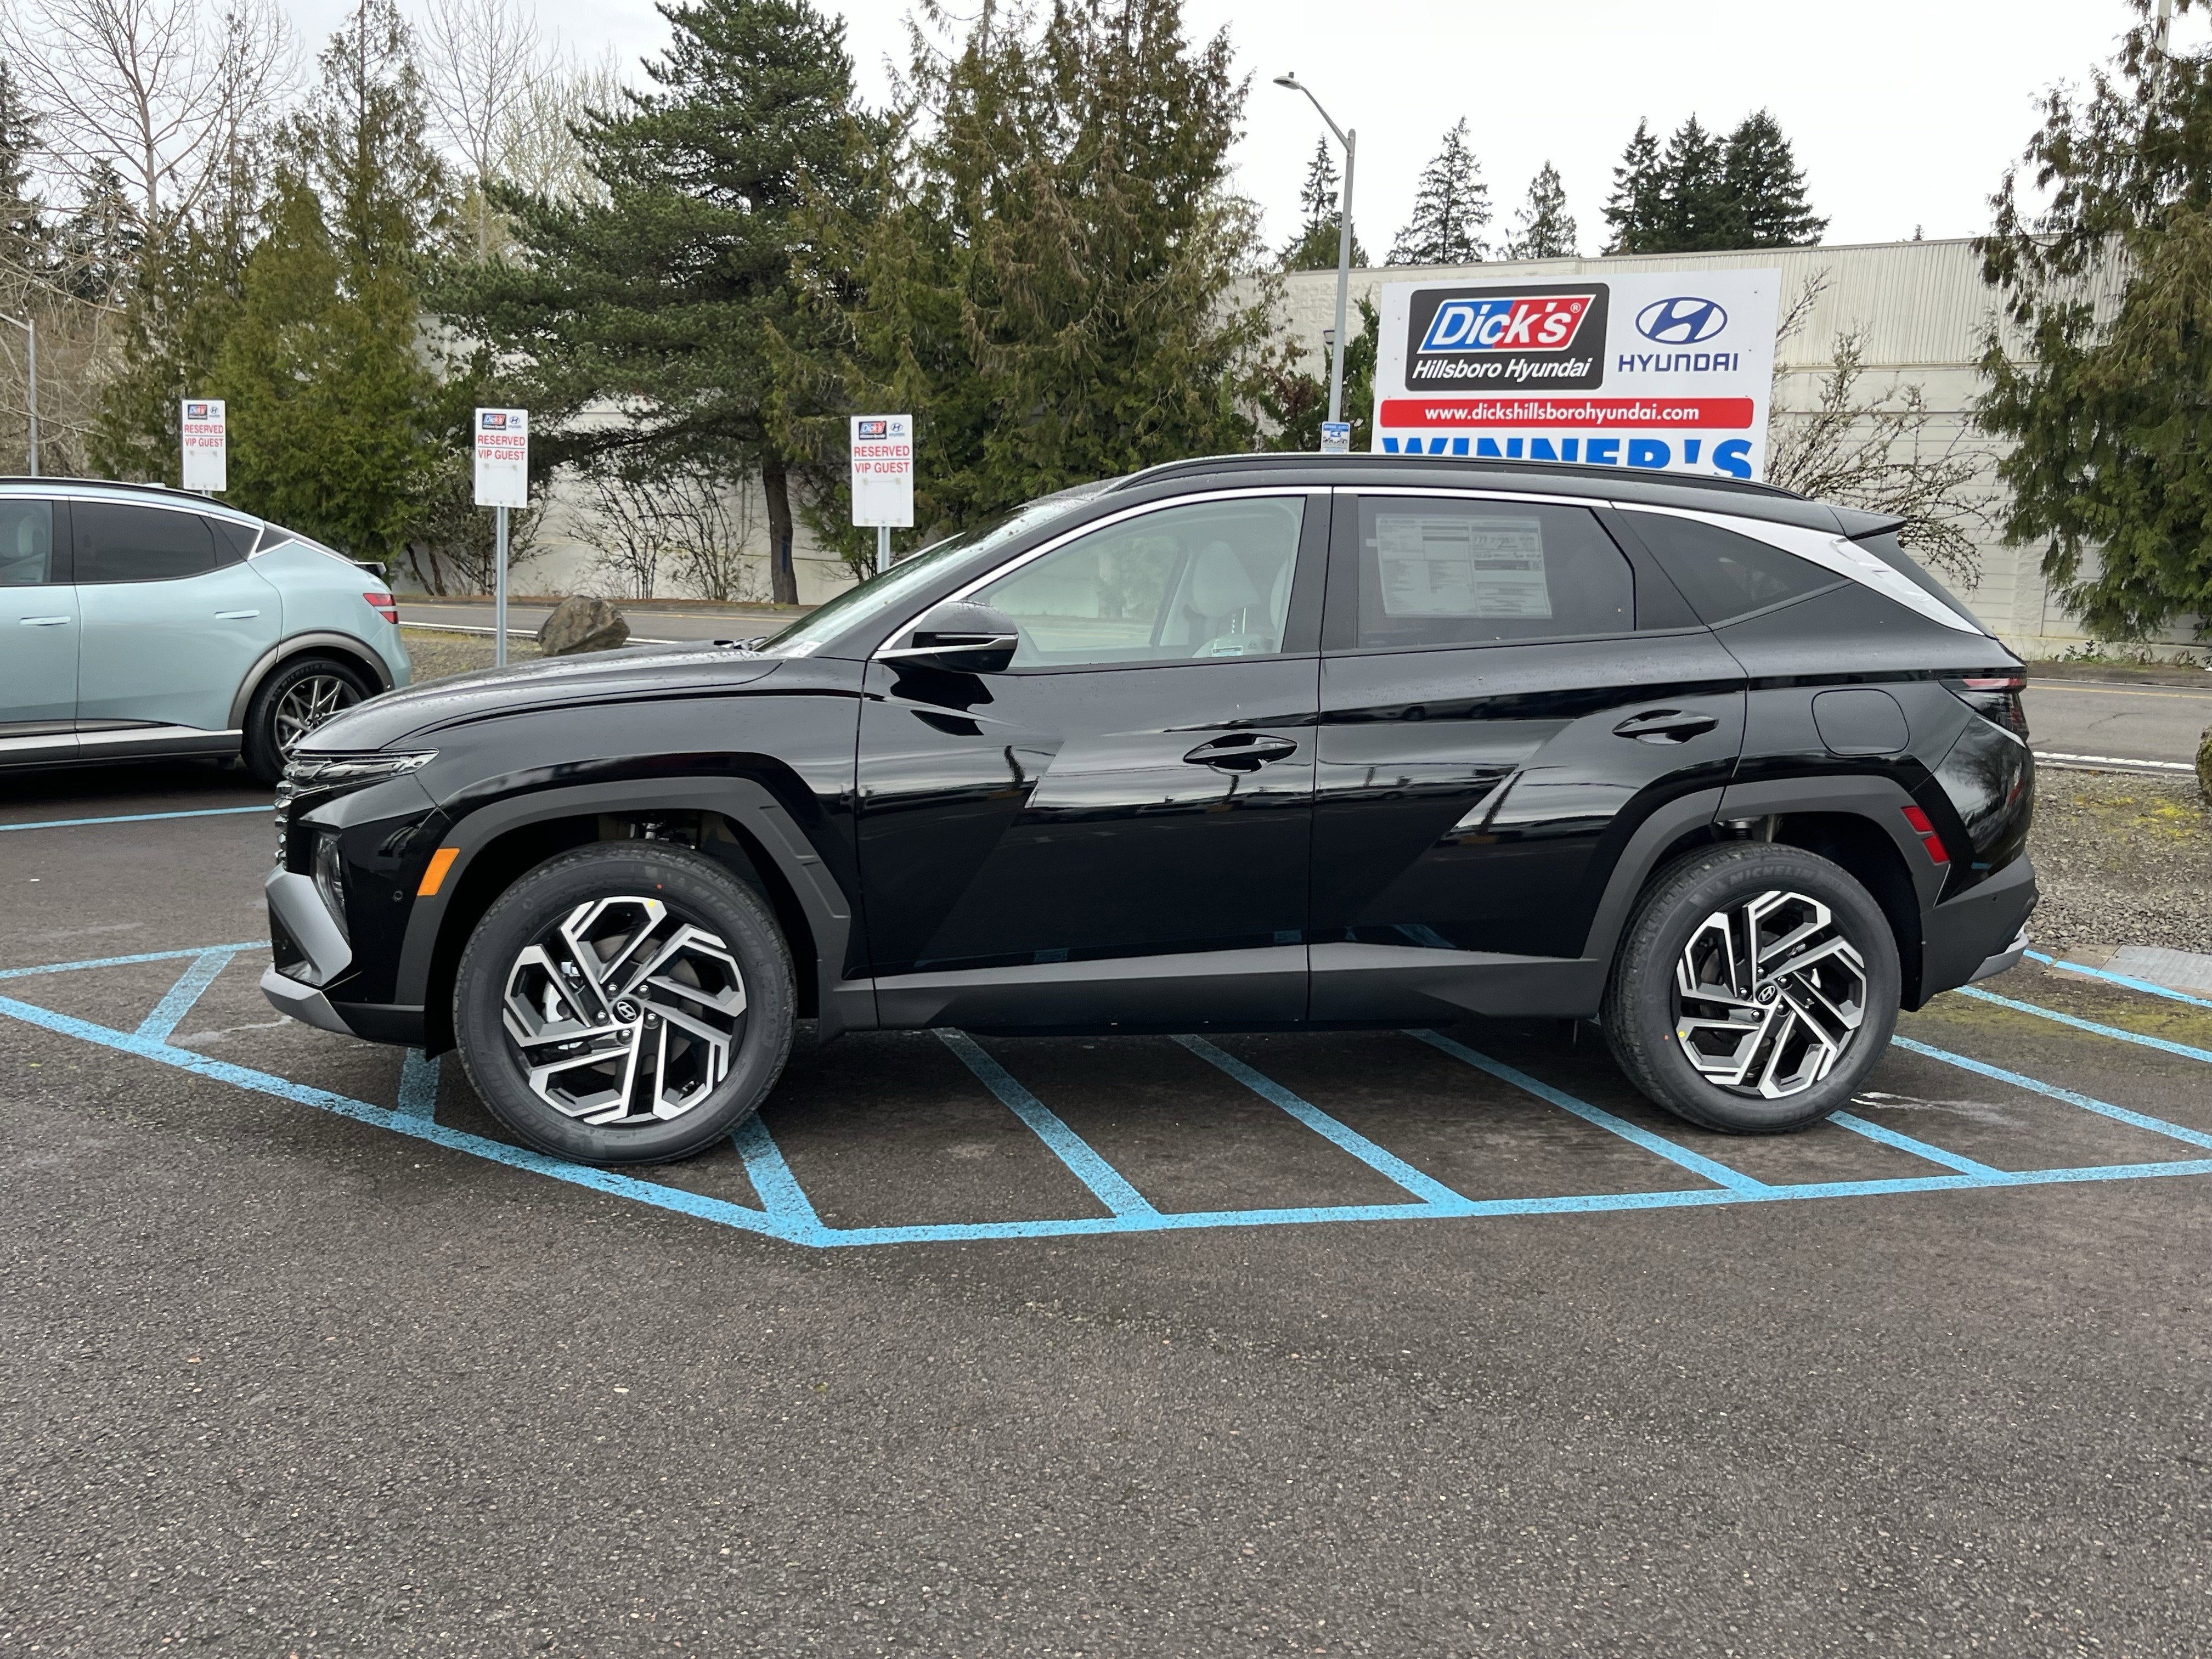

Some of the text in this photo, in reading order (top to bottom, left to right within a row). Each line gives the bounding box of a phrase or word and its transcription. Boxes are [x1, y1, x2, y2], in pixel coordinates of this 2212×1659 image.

[1618, 353, 1739, 372] HYUNDAI
[1412, 357, 1593, 382] Hillsboro Hyundai
[1425, 402, 1700, 425] www.dickshillsborohyundai.com
[184, 424, 224, 434] RESERVED
[185, 438, 224, 447] VIP GUEST
[477, 435, 526, 446] RESERVED
[478, 449, 526, 460] VIP GUEST
[854, 445, 910, 457] RESERVED
[1381, 437, 1752, 479] ER'S
[854, 462, 910, 473] VIP GUEST
